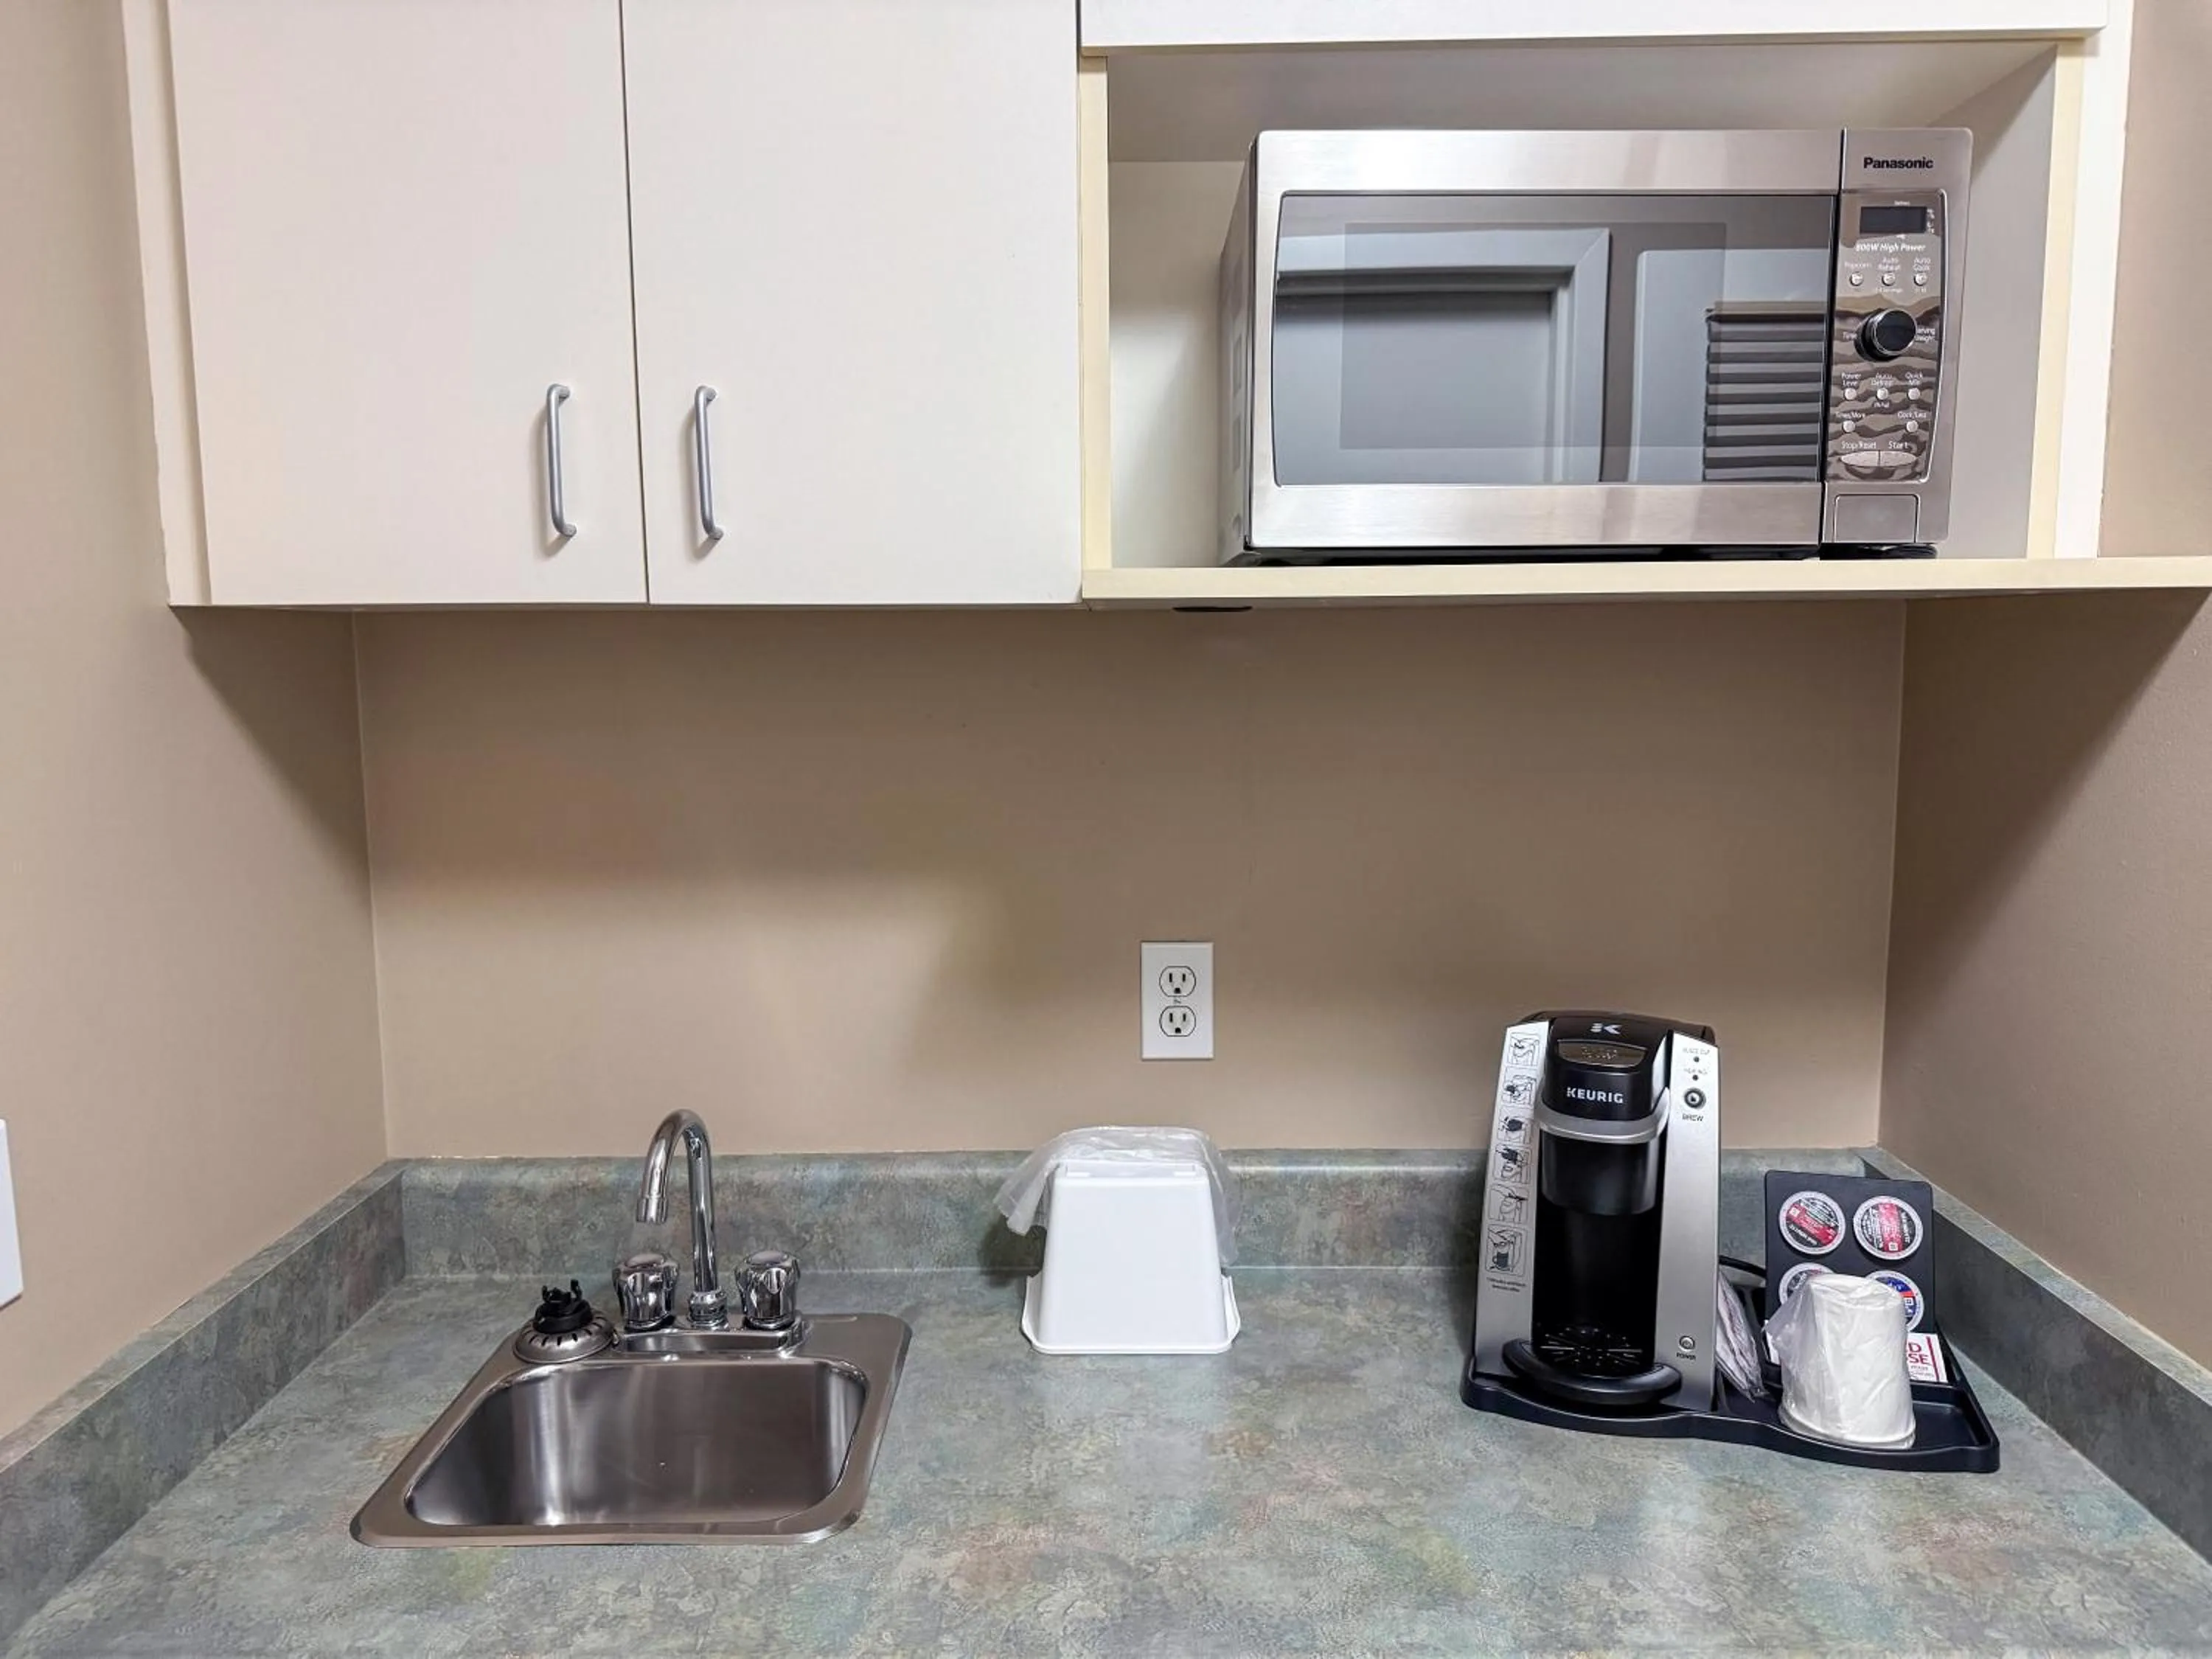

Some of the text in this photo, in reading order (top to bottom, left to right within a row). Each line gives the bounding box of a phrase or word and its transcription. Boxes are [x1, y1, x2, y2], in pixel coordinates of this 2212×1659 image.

[1863, 156, 1934, 169] Panasonic
[1879, 243, 1899, 253] High
[1888, 441, 1908, 449] Start
[1566, 1087, 1624, 1104] KEURIG
[1682, 1113, 1704, 1121] BREW
